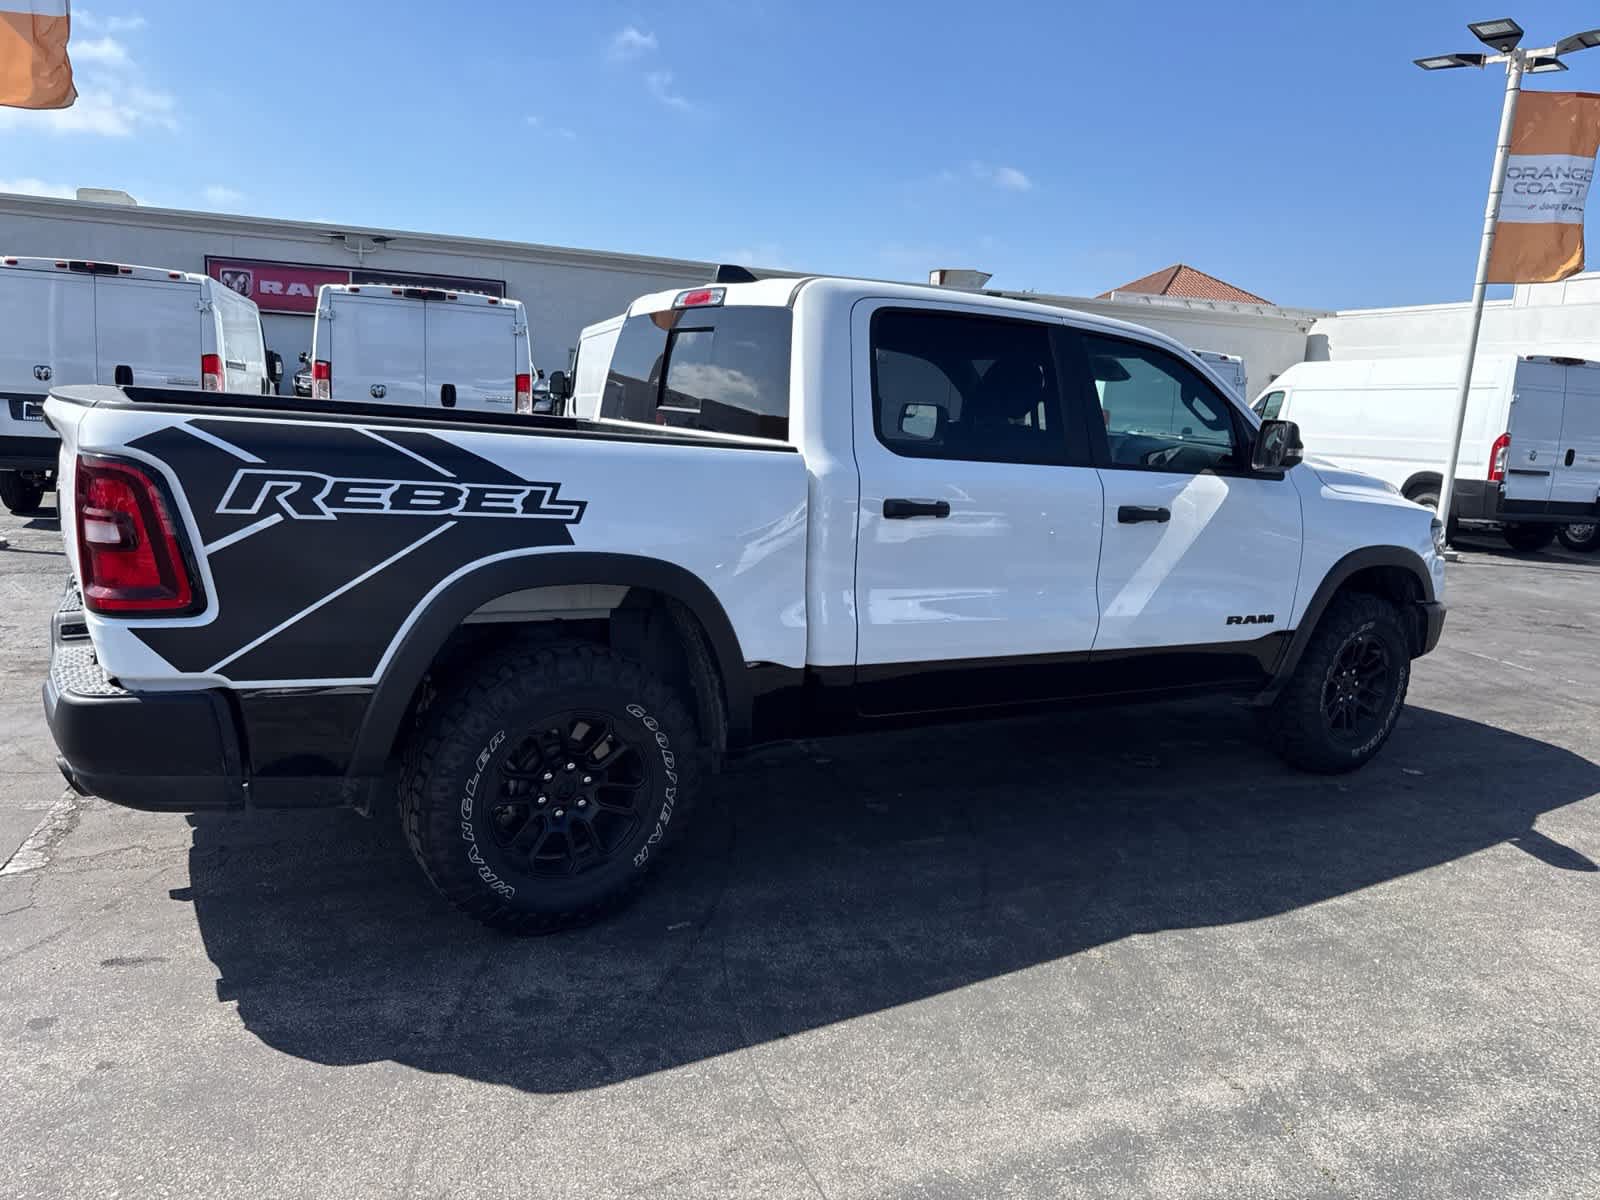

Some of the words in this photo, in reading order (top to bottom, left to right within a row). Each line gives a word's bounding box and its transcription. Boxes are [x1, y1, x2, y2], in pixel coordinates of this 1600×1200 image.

[1507, 166, 1594, 183] ORANGE
[1513, 181, 1585, 197] COAST
[259, 279, 320, 297] RA
[215, 468, 588, 525] REBEL
[1226, 614, 1275, 626] RAM
[626, 703, 678, 867] GOODYEAR
[461, 729, 516, 900] WRANGLER
